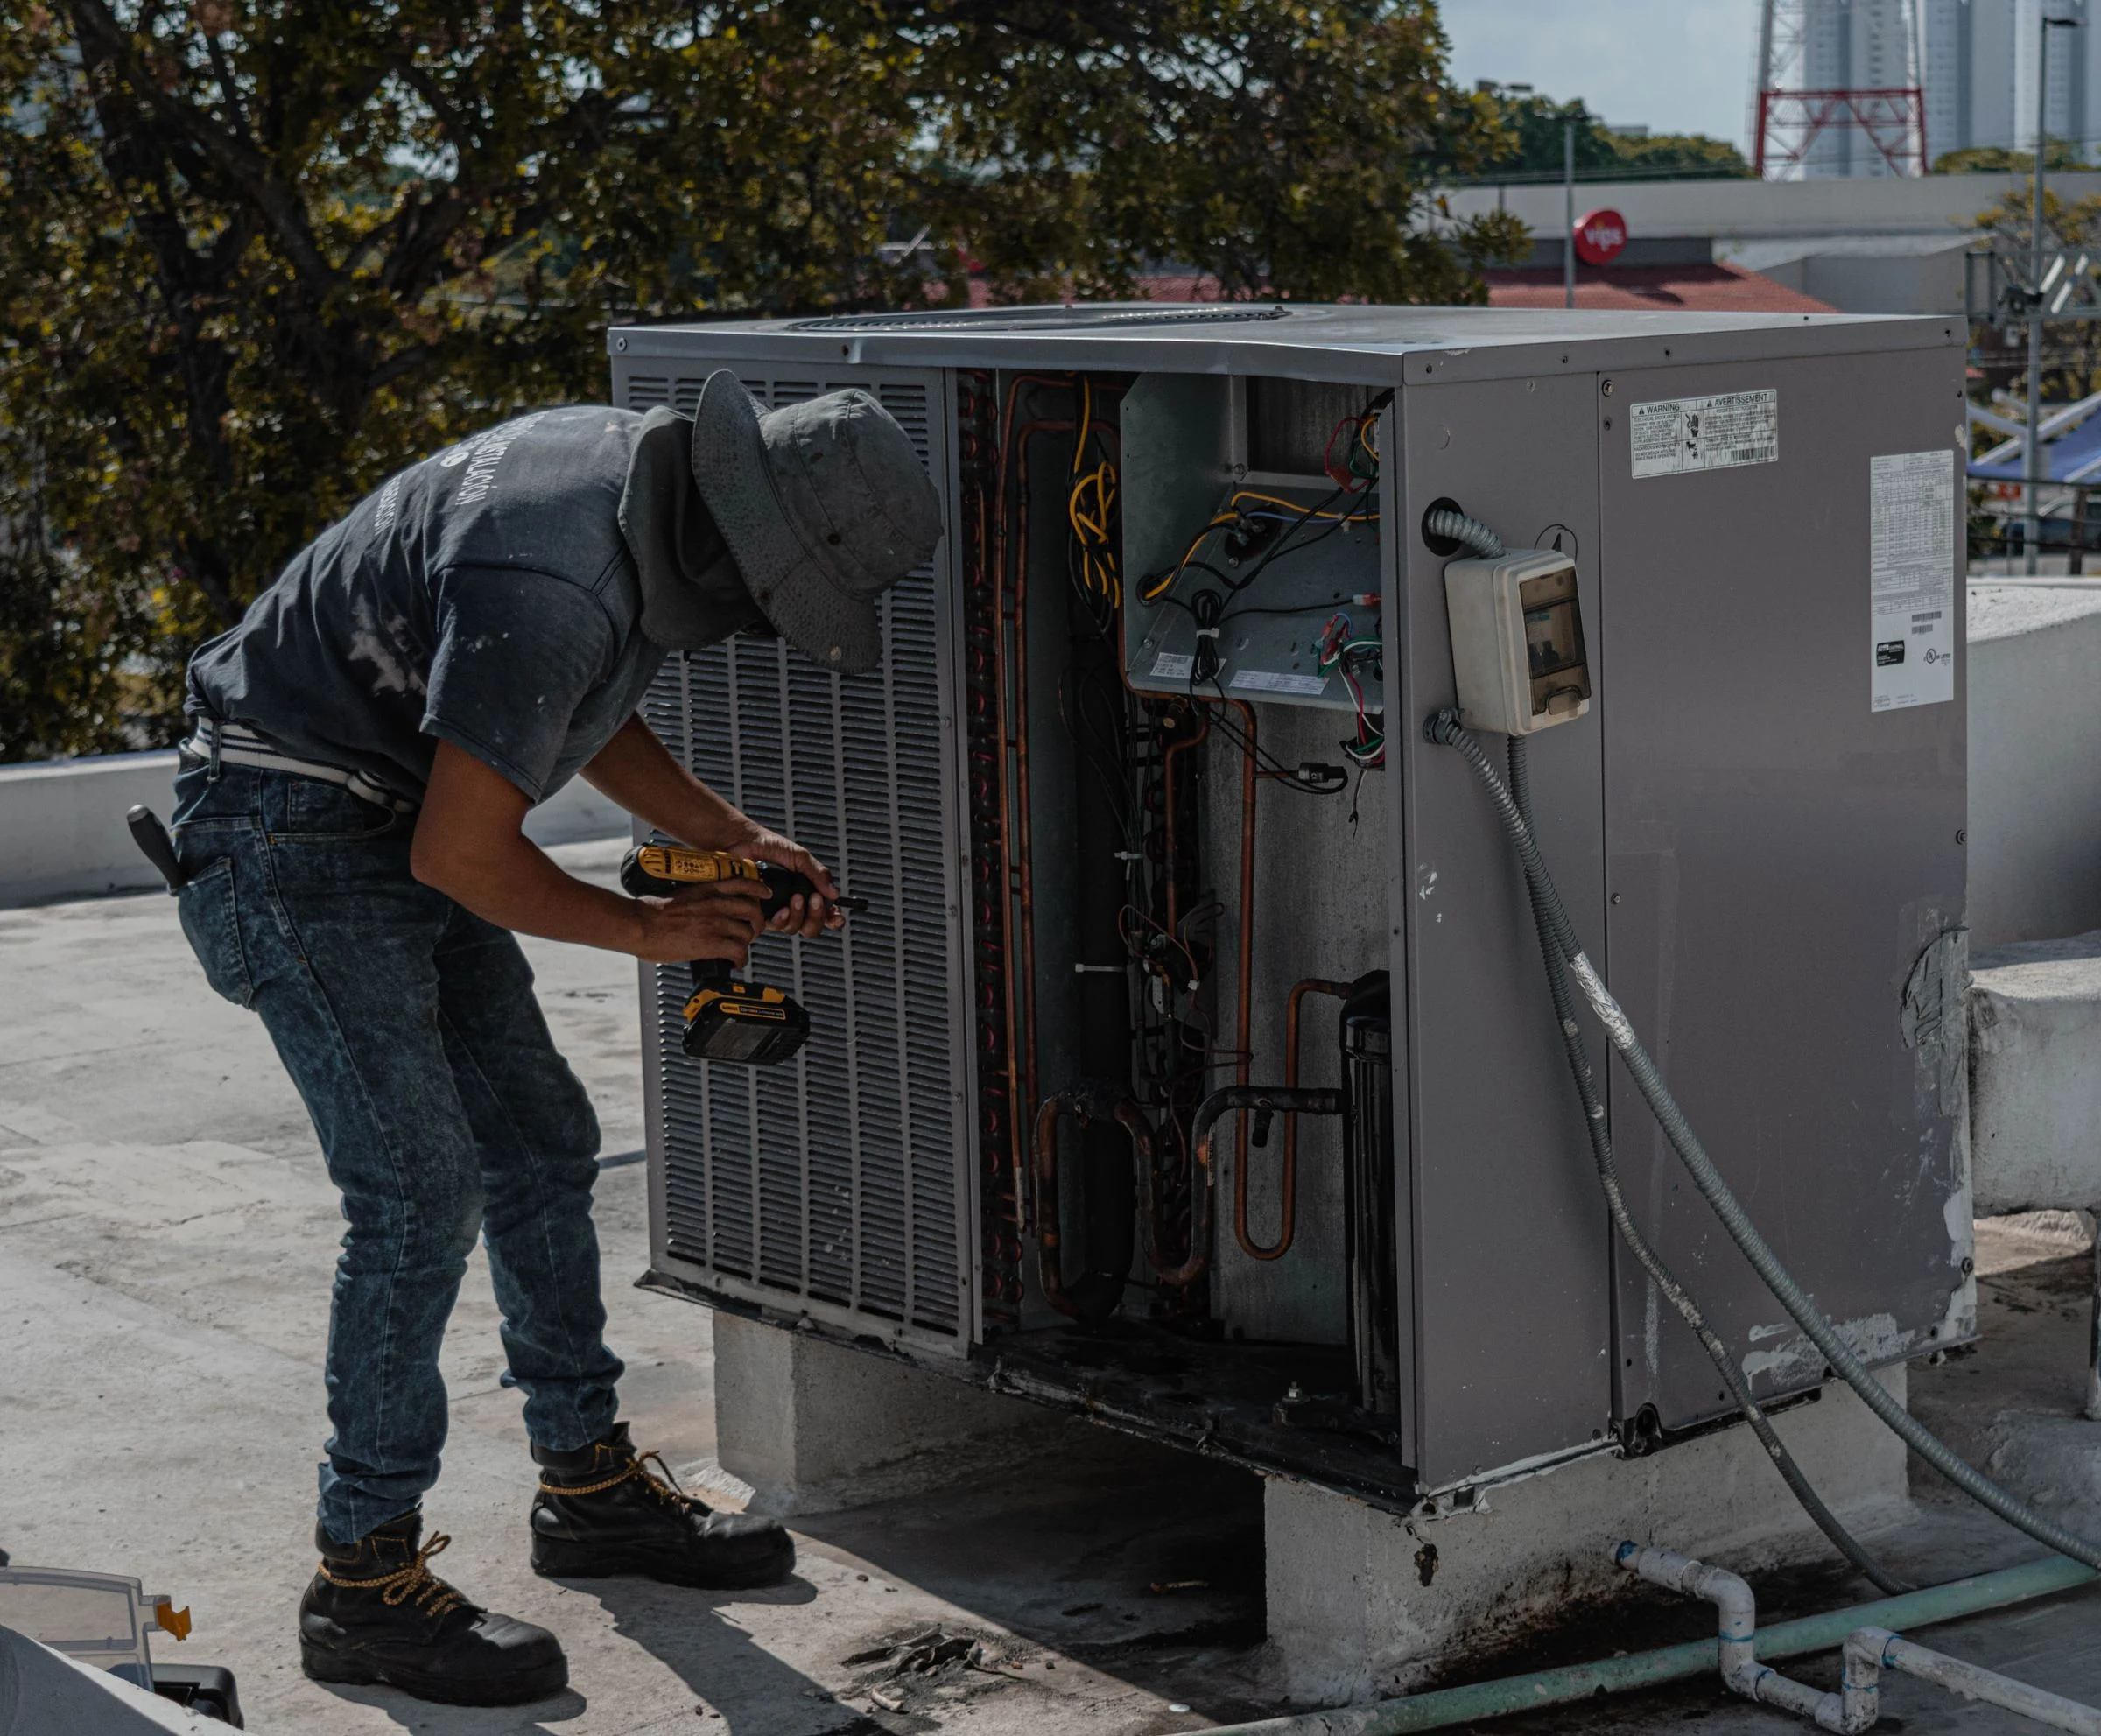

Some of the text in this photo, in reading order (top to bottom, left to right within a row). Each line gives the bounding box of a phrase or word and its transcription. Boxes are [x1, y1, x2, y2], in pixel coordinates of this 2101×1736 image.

[1584, 225, 1622, 252] vips
[1714, 394, 1768, 407] AVERTISSEMENT
[1647, 403, 1680, 414] WARNING
